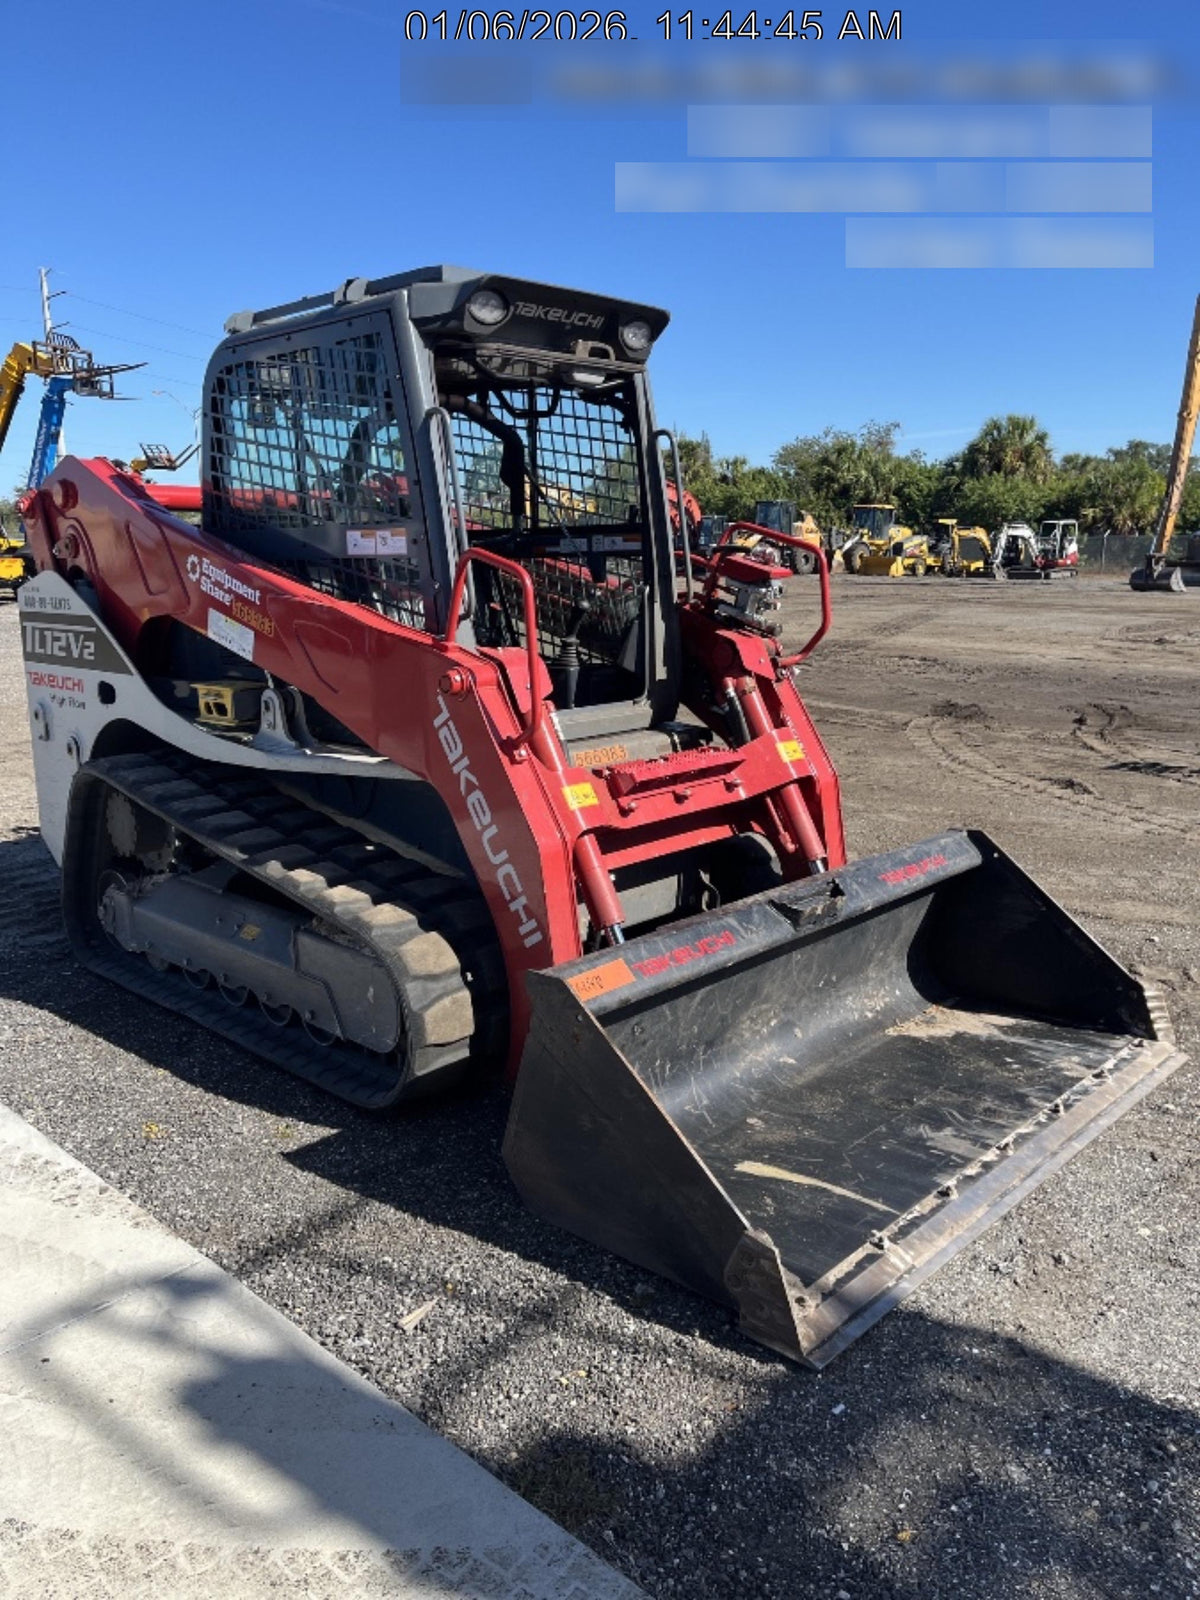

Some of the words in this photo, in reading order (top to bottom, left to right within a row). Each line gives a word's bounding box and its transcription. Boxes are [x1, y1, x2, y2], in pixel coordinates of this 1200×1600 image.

[514, 301, 606, 329] TAKEUCHI
[200, 575, 232, 606] Share
[201, 557, 261, 606] Equipment
[28, 671, 84, 694] TAKEUCHI
[432, 694, 544, 949] TAKEUCHI
[632, 930, 736, 978] TAKEUCHI
